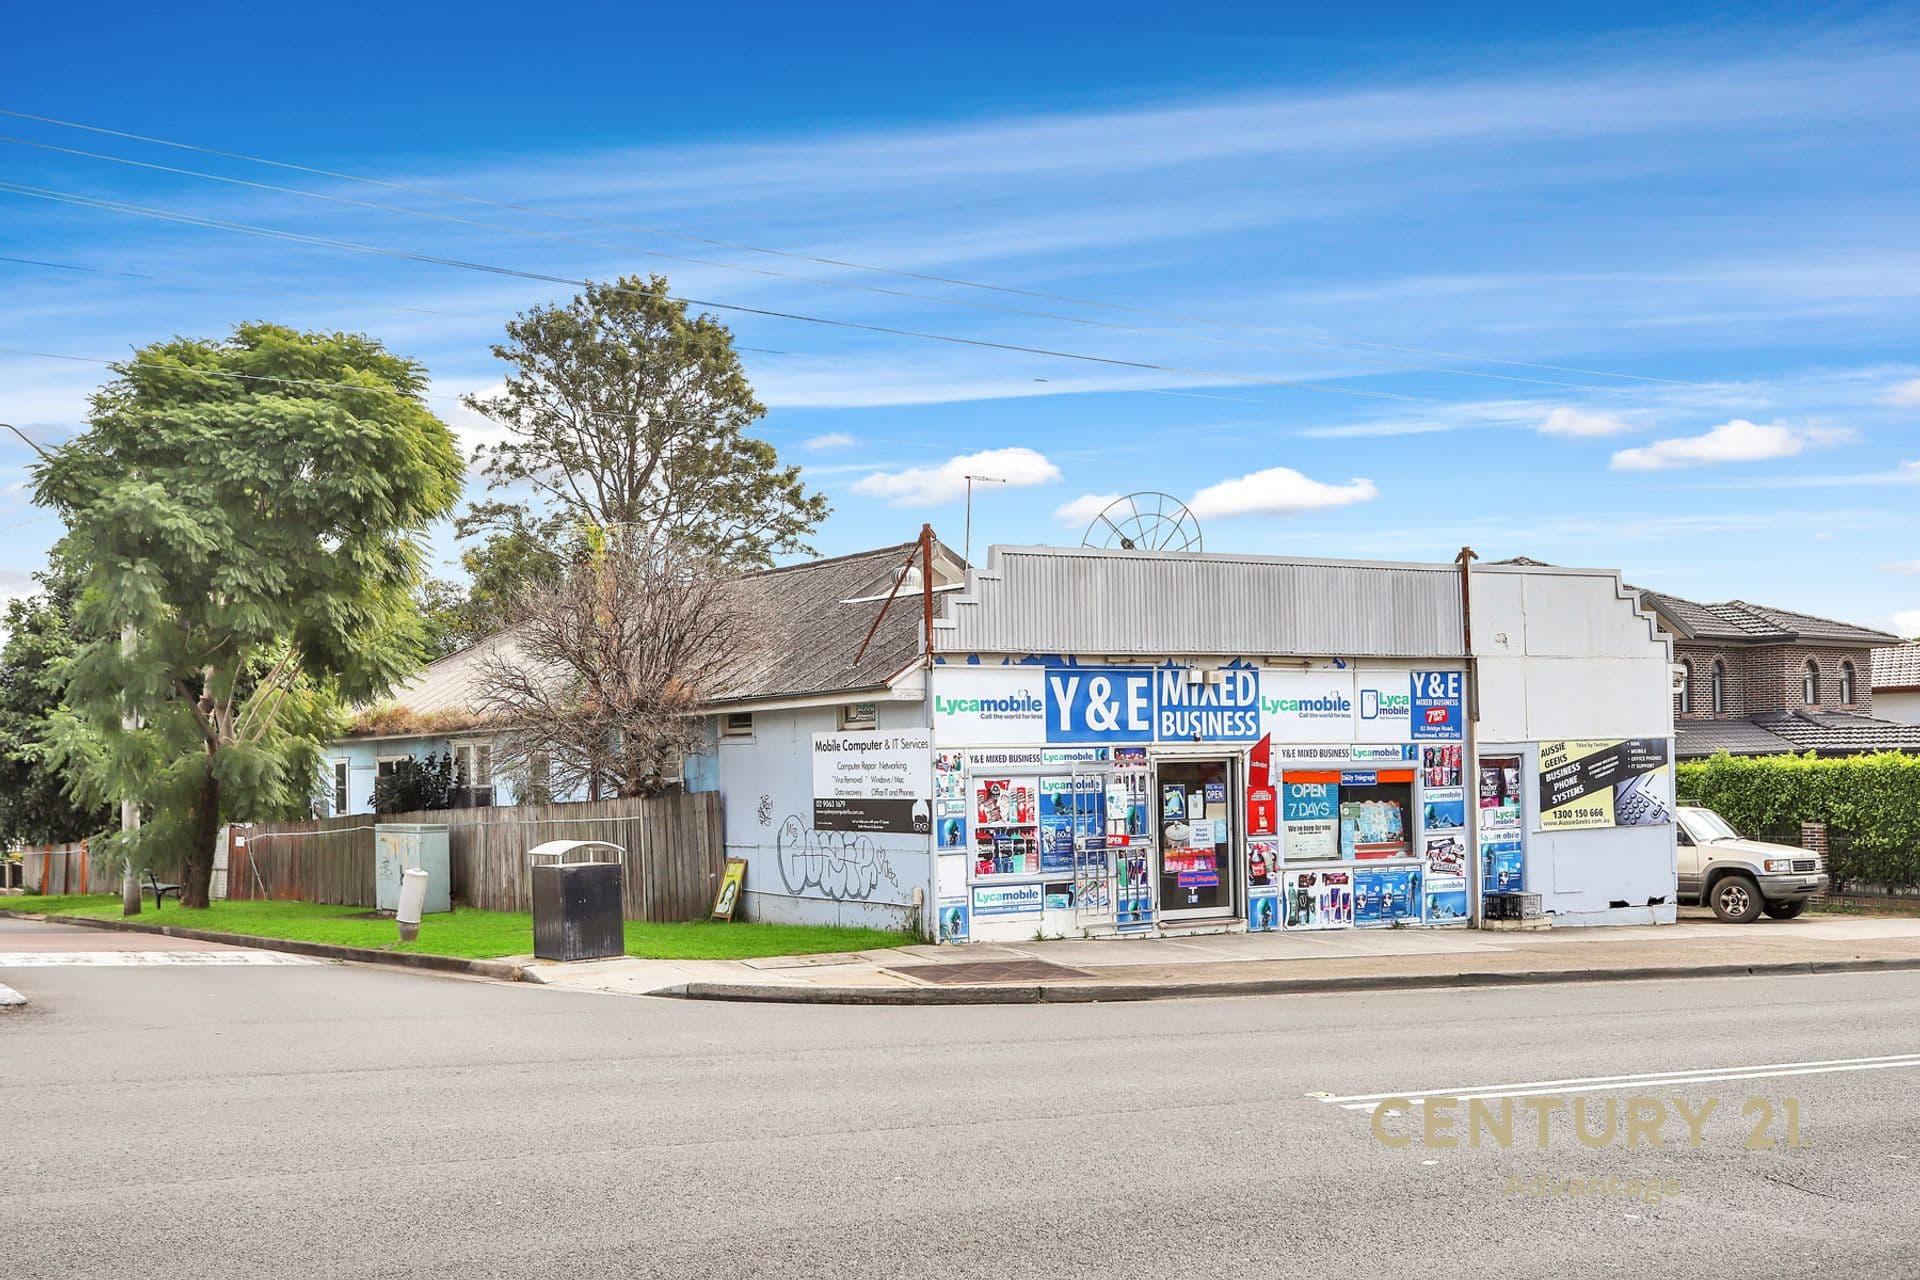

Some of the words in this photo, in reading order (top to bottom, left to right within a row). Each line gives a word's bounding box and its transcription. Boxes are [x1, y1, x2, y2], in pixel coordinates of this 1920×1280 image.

[1161, 670, 1256, 706] MIXED
[1412, 673, 1459, 698] Y&E
[936, 694, 1042, 715] Lycamobile
[1050, 676, 1150, 732] Y&E
[1262, 694, 1350, 714] Lycamobile
[1380, 692, 1409, 707] Lyca
[1380, 706, 1409, 714] mobile
[1162, 711, 1256, 736] BUSINESS
[815, 739, 840, 752] Mobile
[842, 739, 882, 754] Computer
[885, 739, 890, 750] &
[892, 738, 899, 749] IT
[901, 738, 929, 750] Services
[1282, 749, 1296, 758] Y&E
[1297, 749, 1318, 758] MIXED
[1319, 748, 1349, 758] BUSINESS
[1353, 748, 1400, 758] Lycamobile
[1541, 742, 1566, 758] AUSSIE
[969, 754, 984, 764] Y&E
[986, 754, 1007, 763] MIXED
[1009, 753, 1040, 763] BUSINESS
[1044, 753, 1094, 762] Lycamobile
[1544, 754, 1568, 768] GEEKS
[837, 762, 860, 772] Computer
[861, 761, 877, 771] Repair
[879, 761, 907, 772] Networking
[1546, 762, 1580, 782] BUSINESS
[1554, 775, 1578, 792] PHONE
[1206, 791, 1224, 799] OPEN
[1292, 784, 1326, 798] OPEN
[1426, 790, 1461, 800] Lycamobile
[1552, 784, 1584, 804] SYSTEMS
[1288, 804, 1296, 816] 7
[1300, 802, 1329, 816] DAYS
[1496, 810, 1514, 819] Lyca
[1553, 810, 1572, 819] 1300
[1575, 809, 1588, 818] 150
[1590, 808, 1603, 817] 666
[1428, 880, 1464, 892] Lycamobile
[976, 889, 1038, 904] Lycamobile
